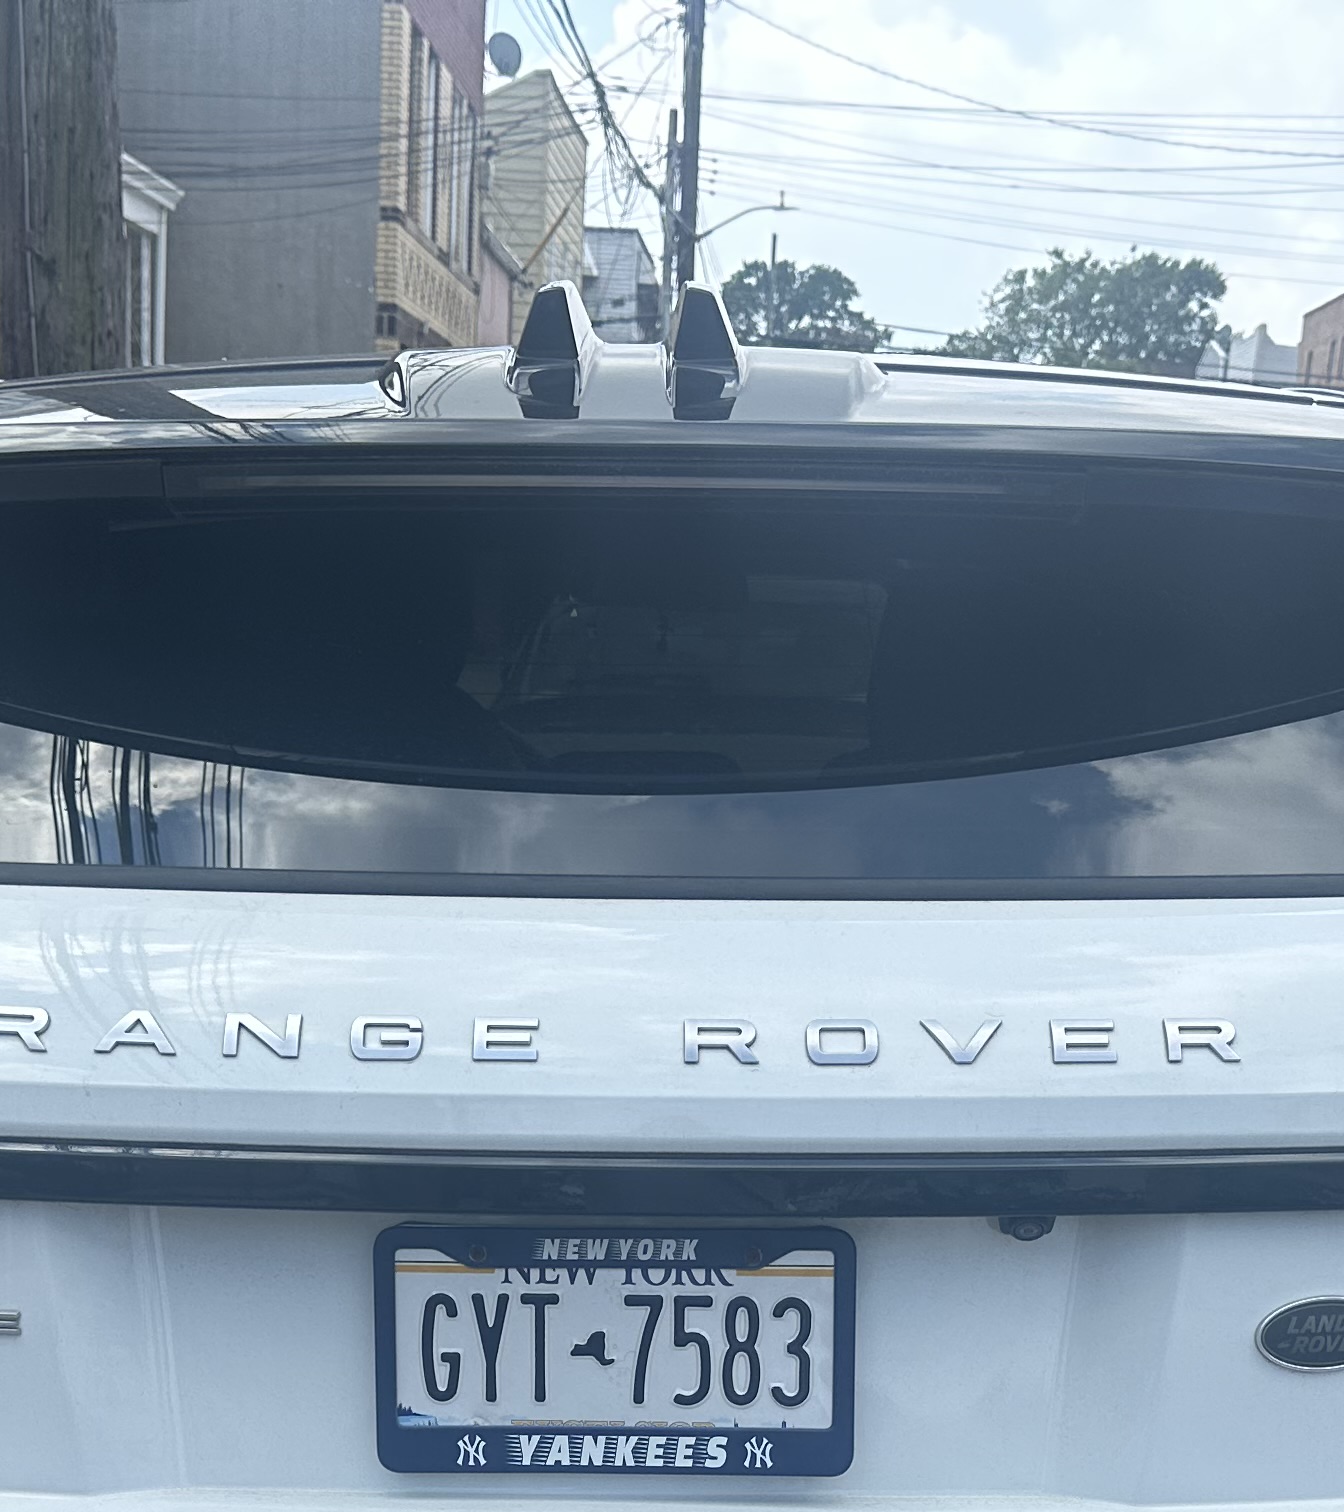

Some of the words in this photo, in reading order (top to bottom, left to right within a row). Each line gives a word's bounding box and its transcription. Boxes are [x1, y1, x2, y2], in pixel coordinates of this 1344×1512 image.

[682, 1017, 1242, 1066] ROVER
[536, 1238, 609, 1261] NEW
[618, 1238, 699, 1261] YORK
[421, 1293, 560, 1404] GYT
[623, 1295, 812, 1407] 7583
[516, 1434, 728, 1468] YANKEES
